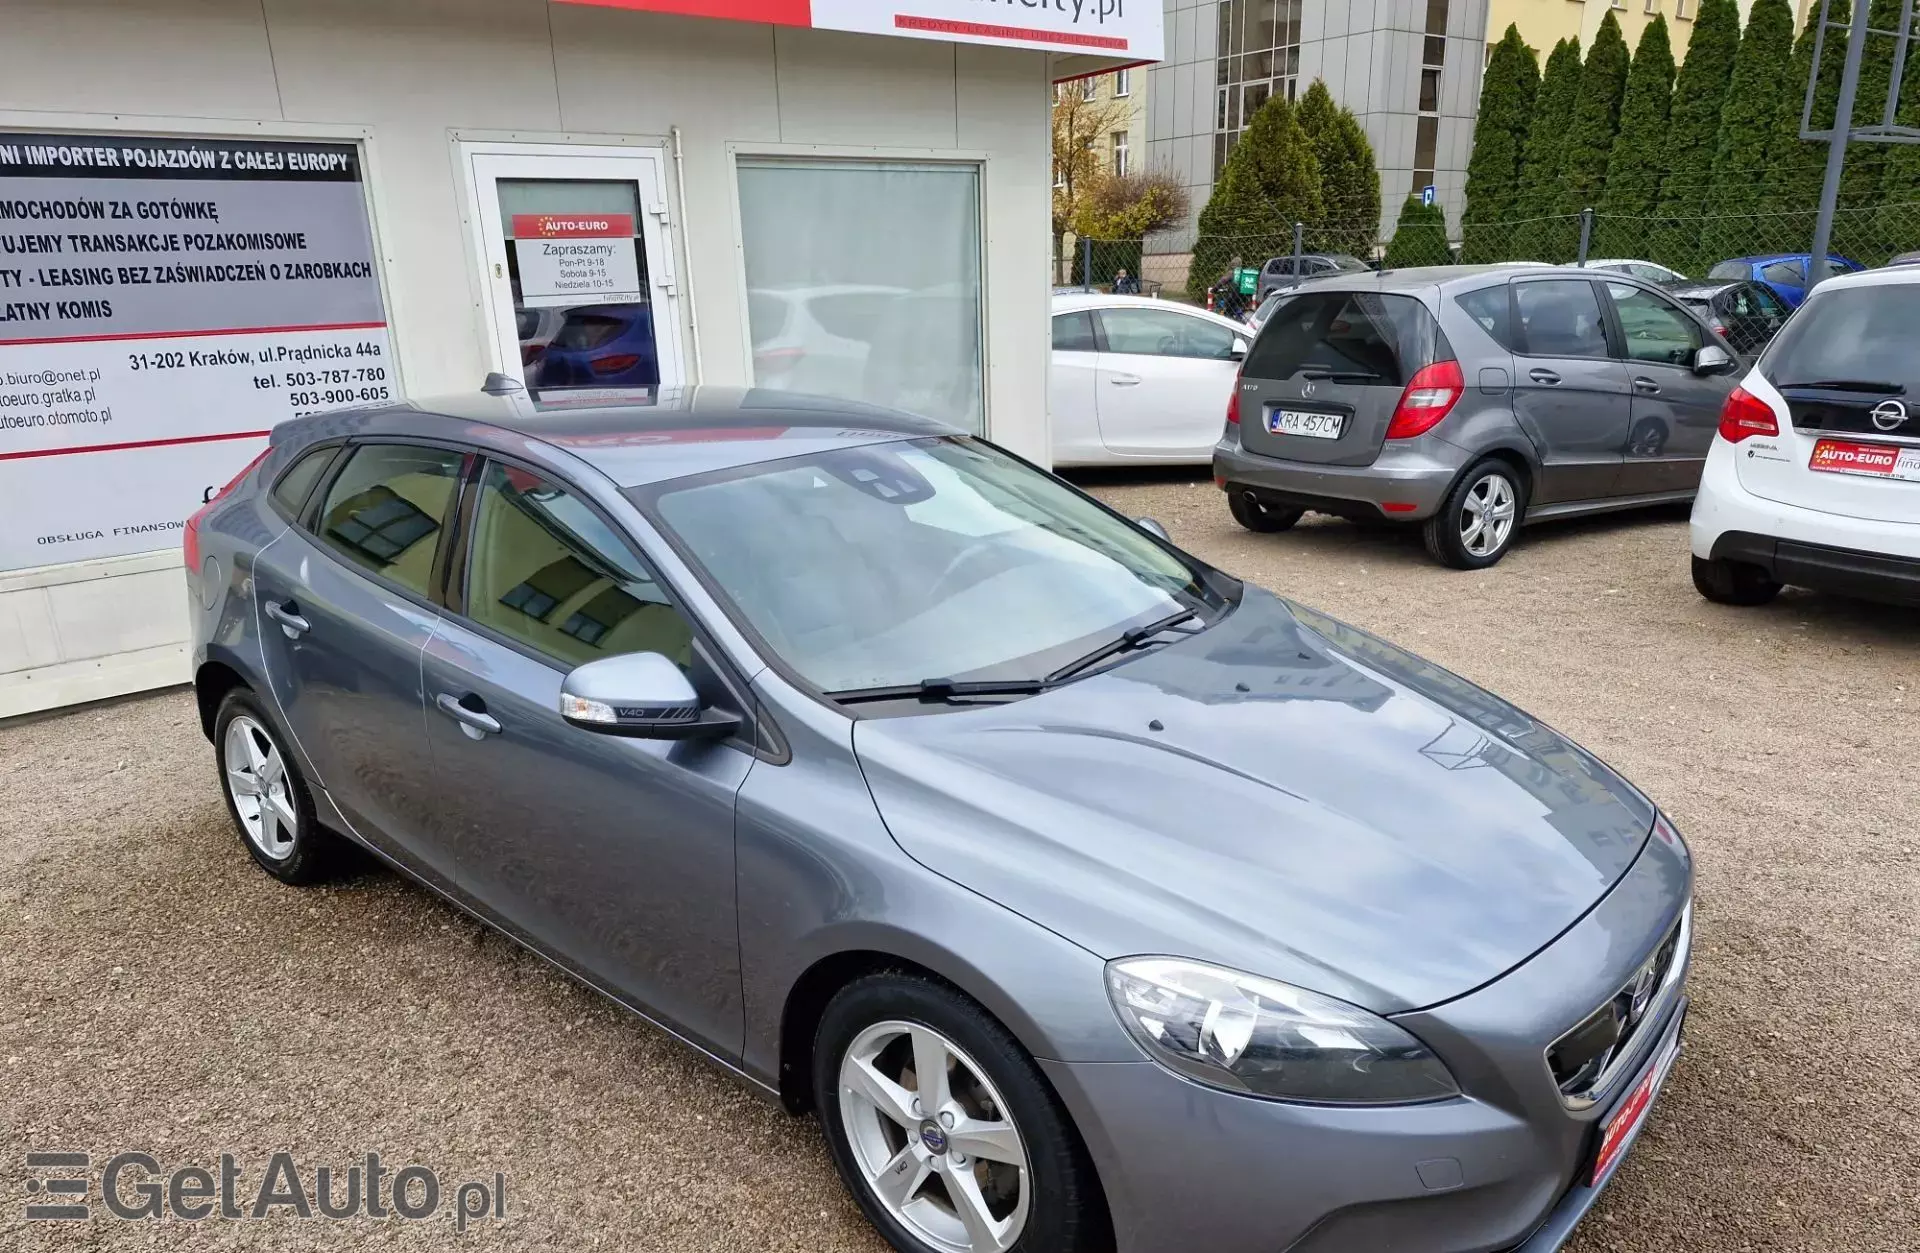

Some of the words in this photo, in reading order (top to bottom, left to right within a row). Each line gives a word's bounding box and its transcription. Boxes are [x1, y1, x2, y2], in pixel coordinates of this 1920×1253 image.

[24, 145, 120, 167] IMPORTER
[122, 145, 216, 169] POJAZDÓW
[219, 151, 232, 169] Z
[234, 151, 284, 170] CAŁEJ
[288, 153, 348, 171] EUROPY
[109, 202, 133, 219] ZA
[137, 197, 219, 224] GOTÓWKĘ
[545, 221, 609, 231] AUTO-EURO
[0, 235, 62, 253] UJEMY
[67, 234, 180, 252] TRANSAKCJE
[183, 233, 307, 251] POZAKOMISOWE
[542, 243, 617, 257] Zapraszamy:
[588, 257, 605, 267] 9-18
[38, 268, 114, 286] LEASING
[117, 267, 151, 284] BEZ
[154, 260, 266, 284] ZAŚWIADCZEŃ
[270, 264, 281, 280] O
[284, 262, 372, 280] ZAROBKACH
[560, 269, 587, 279] Sobota
[588, 268, 607, 278] 9-15
[555, 280, 591, 290] Niedziela
[592, 279, 614, 288] 10-15
[0, 302, 50, 321] ATNY
[56, 300, 113, 319] KOMIS
[129, 351, 186, 371] 31-202
[189, 347, 255, 367] Kraków,
[259, 343, 352, 364] ul.Prądnicka
[356, 341, 381, 357] 44a
[253, 374, 281, 389] tel.
[286, 367, 385, 386] 503-787-780
[290, 387, 389, 406] 503-900-605
[1278, 413, 1299, 430] KRA
[1303, 415, 1341, 434] 457CM
[1820, 449, 1893, 466] AUTO-EURO
[37, 530, 105, 546] OBSŁUGA
[619, 708, 645, 717] V40
